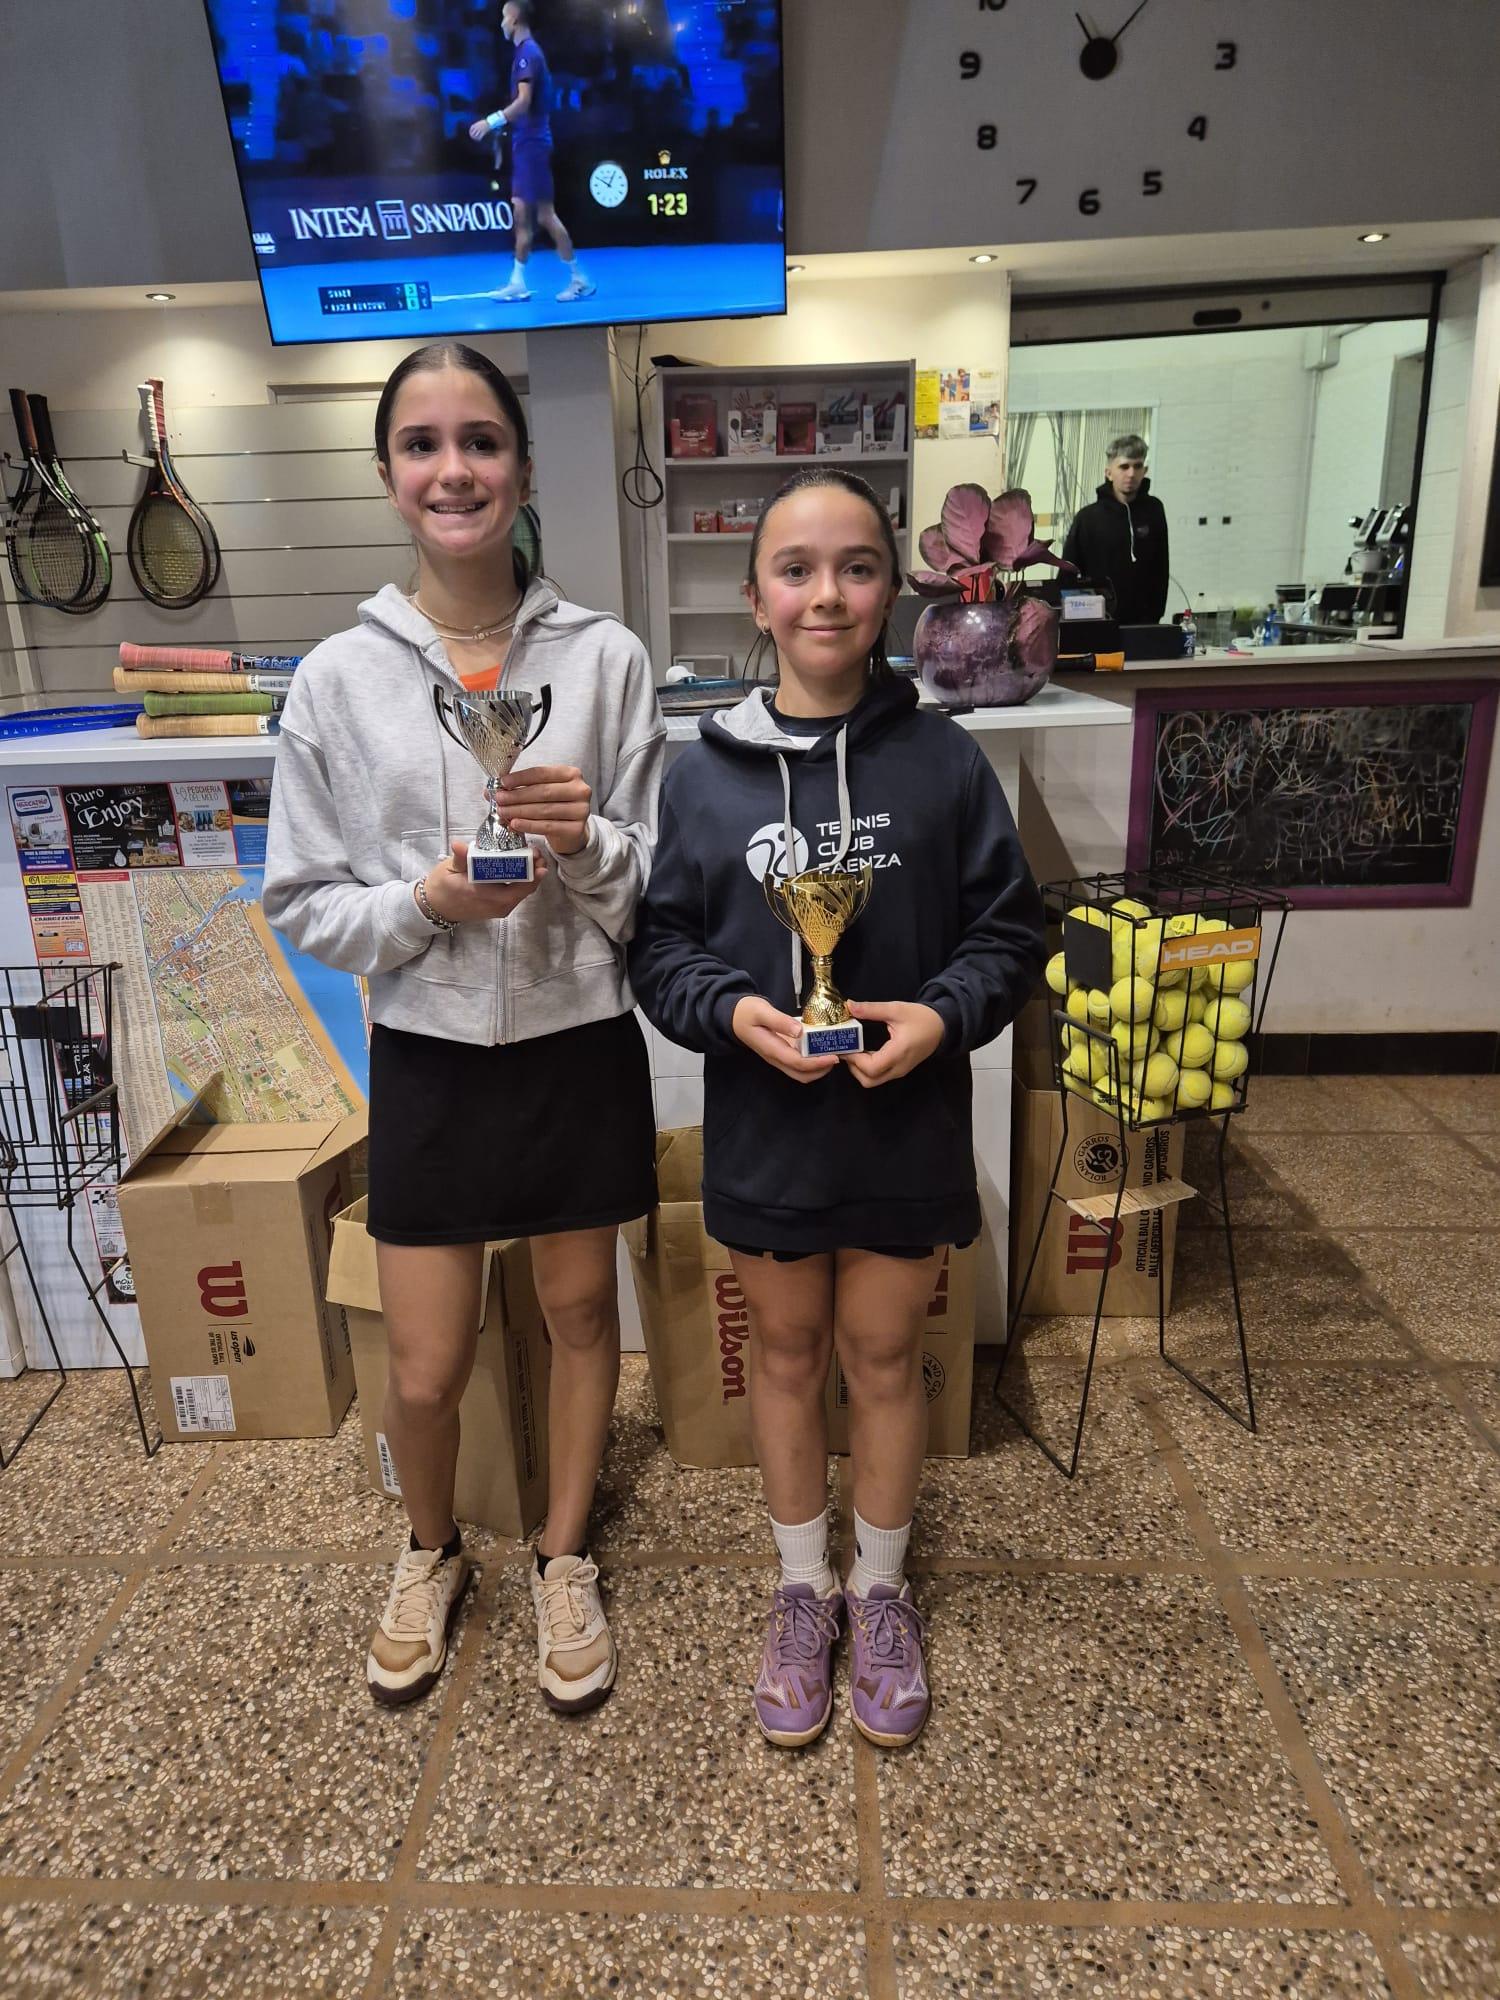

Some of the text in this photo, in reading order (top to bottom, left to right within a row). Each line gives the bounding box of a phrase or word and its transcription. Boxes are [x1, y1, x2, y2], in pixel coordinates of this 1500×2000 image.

[959, 51, 981, 79] 9
[1214, 42, 1237, 70] 3
[976, 124, 997, 150] 8
[1187, 115, 1208, 141] 4
[643, 167, 689, 180] ROLEX
[1142, 170, 1162, 195] 5
[1016, 178, 1037, 204] 7
[1078, 189, 1100, 215] 6
[647, 192, 689, 217] 1:23
[288, 196, 513, 241] INTESA SANPAOLO
[66, 786, 104, 812] Puro
[78, 795, 149, 829] Enjoy
[816, 813, 891, 836] TENIS
[1163, 940, 1254, 964] HEAD
[1078, 1136, 1109, 1157] GARROS
[1143, 1136, 1155, 1170] GARROS
[1077, 1160, 1106, 1181] ROLAND
[1148, 1255, 1159, 1278] BALLE
[1158, 1130, 1170, 1163] GARROS
[1139, 1217, 1149, 1236] BALL
[1136, 1238, 1148, 1272] OFFICIAL
[715, 1273, 750, 1400] Wilson
[923, 1355, 942, 1377] LAND
